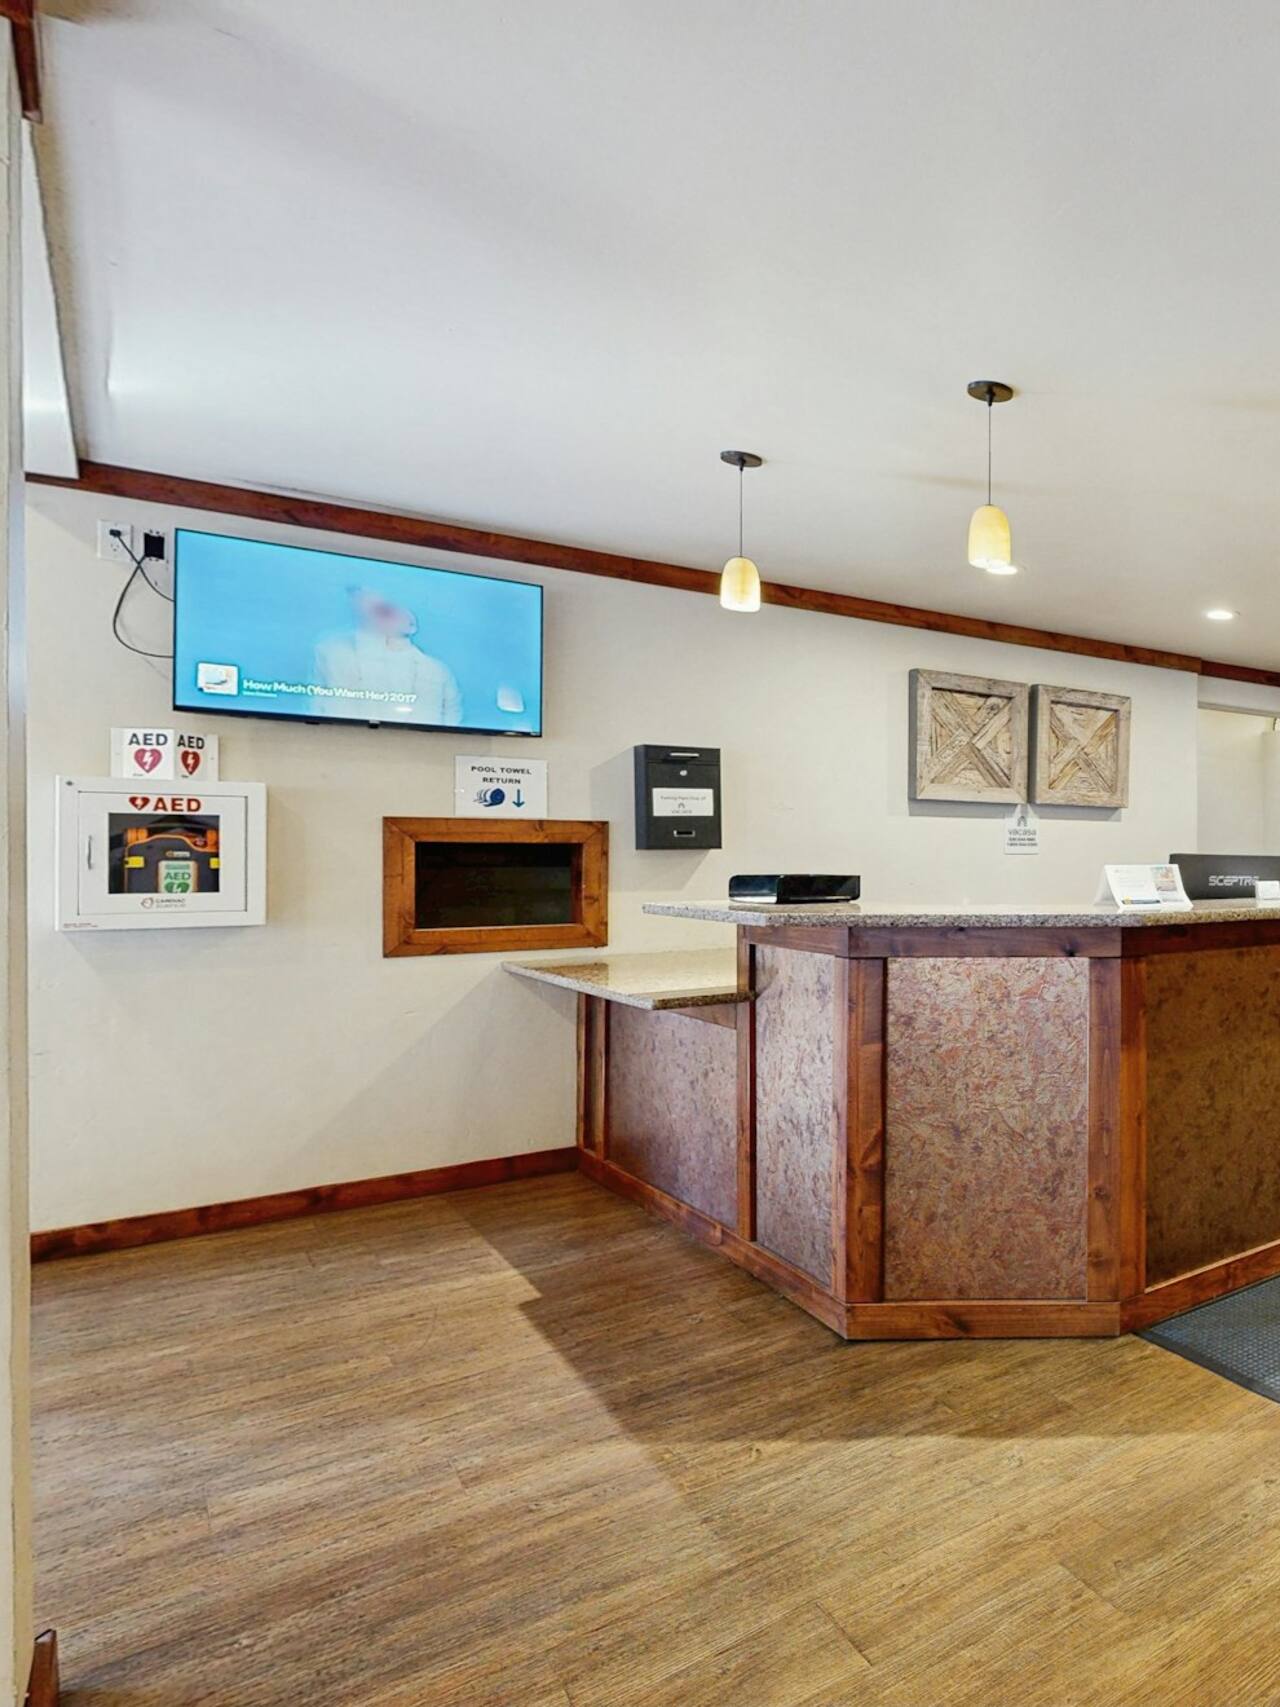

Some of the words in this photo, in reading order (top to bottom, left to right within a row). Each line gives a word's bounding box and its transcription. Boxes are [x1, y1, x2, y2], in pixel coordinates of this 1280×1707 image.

[243, 679, 272, 691] How
[273, 682, 306, 694] Much
[307, 685, 333, 696] (You
[334, 688, 365, 699] Want
[366, 690, 389, 702] Her)
[389, 693, 417, 703] 2017
[128, 733, 168, 746] AED
[177, 735, 205, 749] AED
[500, 767, 532, 775] TOWEL
[153, 797, 202, 812] AED
[164, 872, 191, 881] AED
